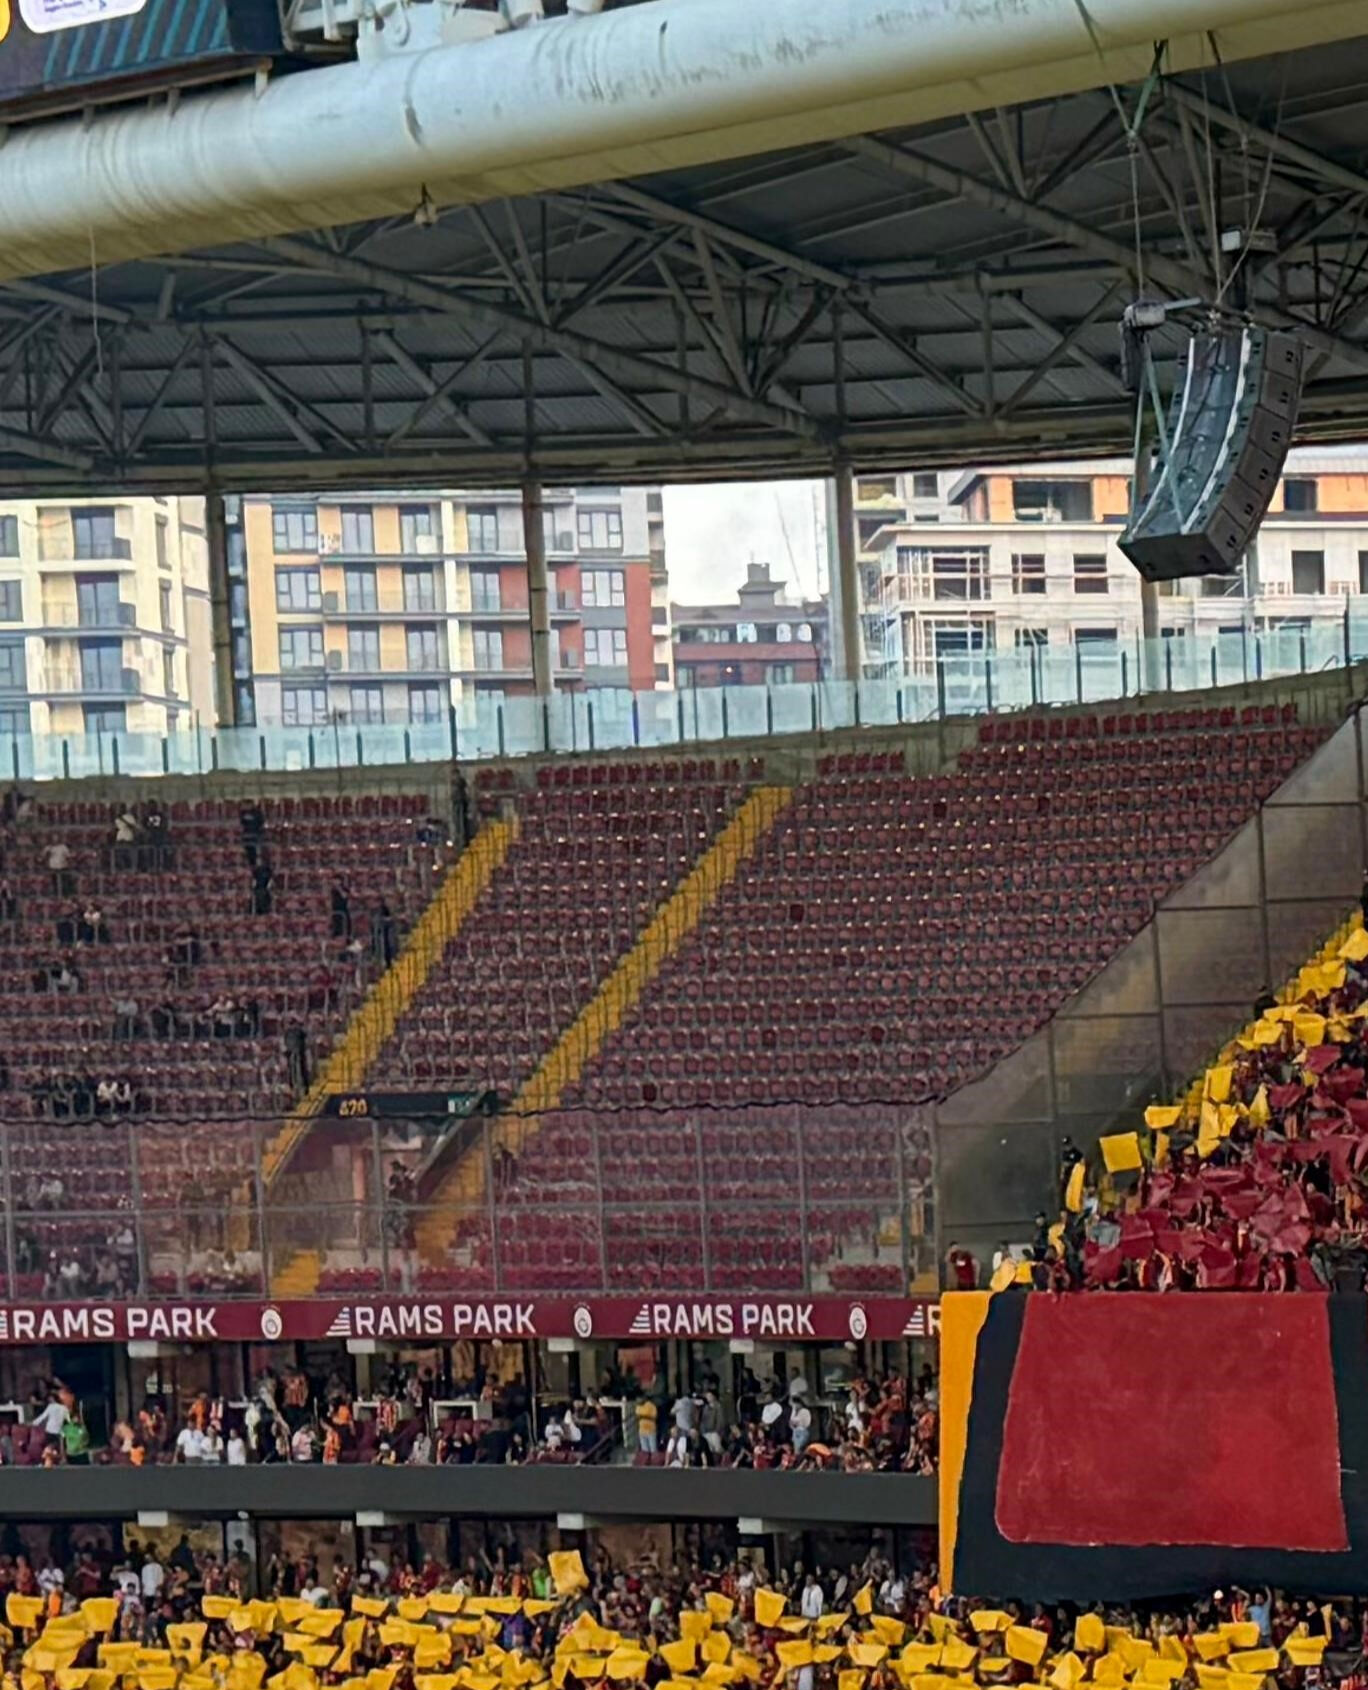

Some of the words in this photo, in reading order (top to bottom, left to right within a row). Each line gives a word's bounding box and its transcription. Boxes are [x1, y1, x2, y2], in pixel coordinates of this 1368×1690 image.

[13, 1308, 115, 1339] RAMS
[127, 1307, 218, 1337] PARK
[355, 1305, 444, 1336] RAMS
[453, 1303, 537, 1334] PARK
[653, 1304, 734, 1334] RAMS
[742, 1304, 816, 1335] PARK
